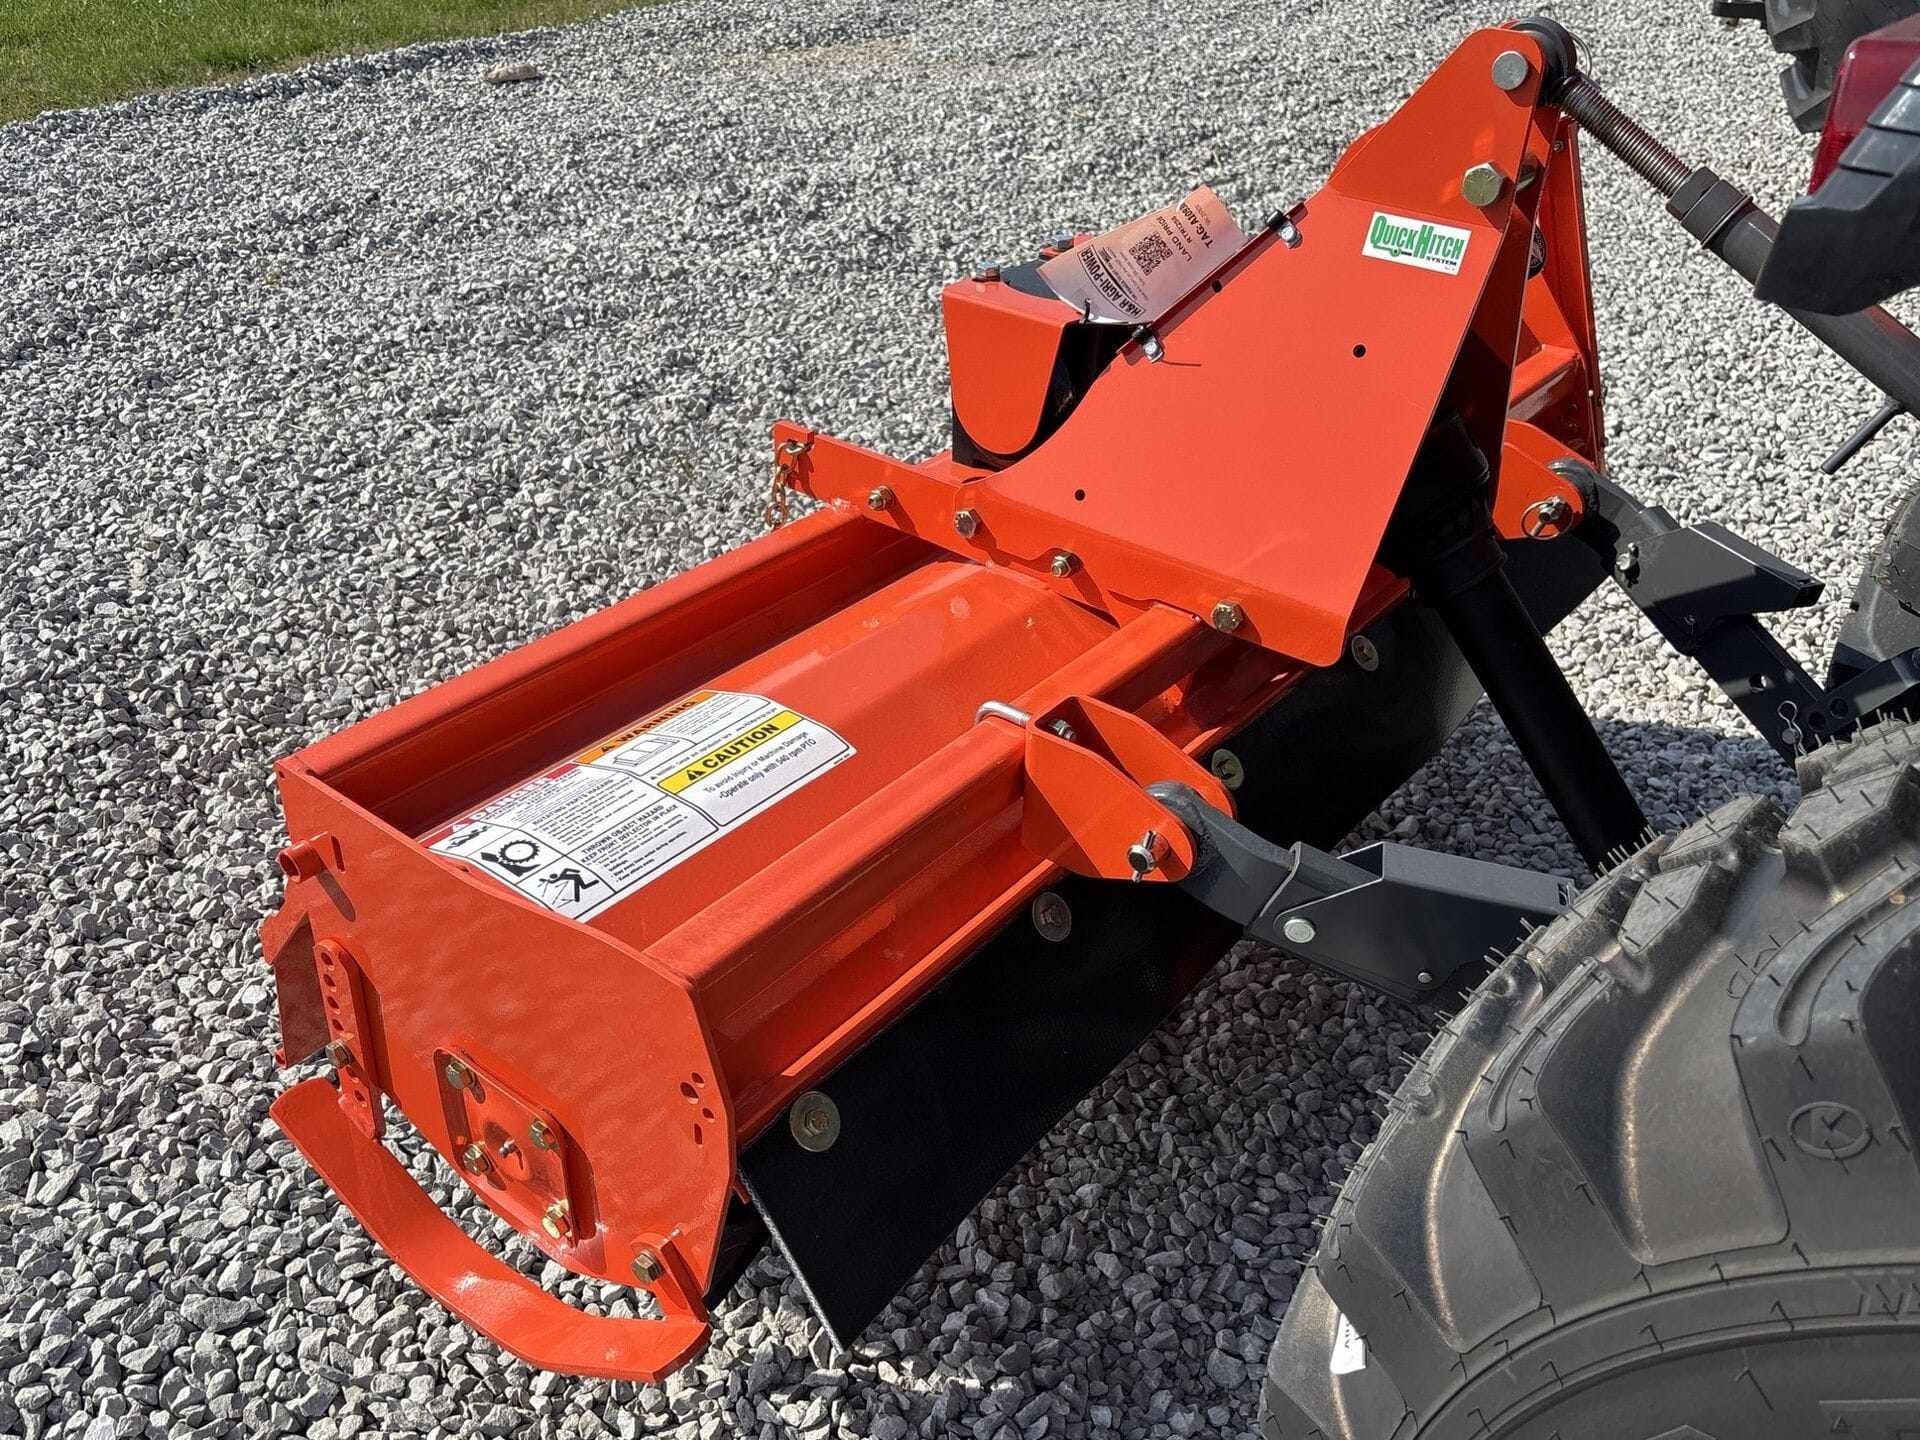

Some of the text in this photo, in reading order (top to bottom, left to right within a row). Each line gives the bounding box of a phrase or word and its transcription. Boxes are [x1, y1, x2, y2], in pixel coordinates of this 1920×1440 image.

[1156, 216, 1192, 262] LAND PRIDE
[1195, 222, 1213, 248] TAG:
[1081, 248, 1141, 317] H&R AGRI-POWER
[1426, 256, 1457, 266] SYSTEM
[615, 702, 696, 742] WARNING
[702, 724, 780, 769] CAUTION
[704, 785, 715, 793] To
[716, 775, 734, 789] avoid
[757, 744, 783, 763] Machine
[784, 731, 808, 748] Damage
[747, 769, 764, 783] only
[761, 760, 777, 774] with
[775, 753, 789, 765] 540
[788, 746, 803, 759] rpm
[801, 738, 817, 753] PTO
[472, 778, 555, 820] DANGER
[532, 806, 566, 824] ROTATING
[566, 793, 588, 806] PARTS
[587, 779, 614, 794] HAZARD
[580, 835, 612, 854] THROWN
[611, 820, 638, 838] OBJECT
[638, 804, 664, 822] HAZARD
[582, 852, 598, 864] KEEP
[599, 841, 619, 854] FRONT
[618, 820, 652, 843] DEFLECTOR
[660, 804, 678, 817] PLACE
